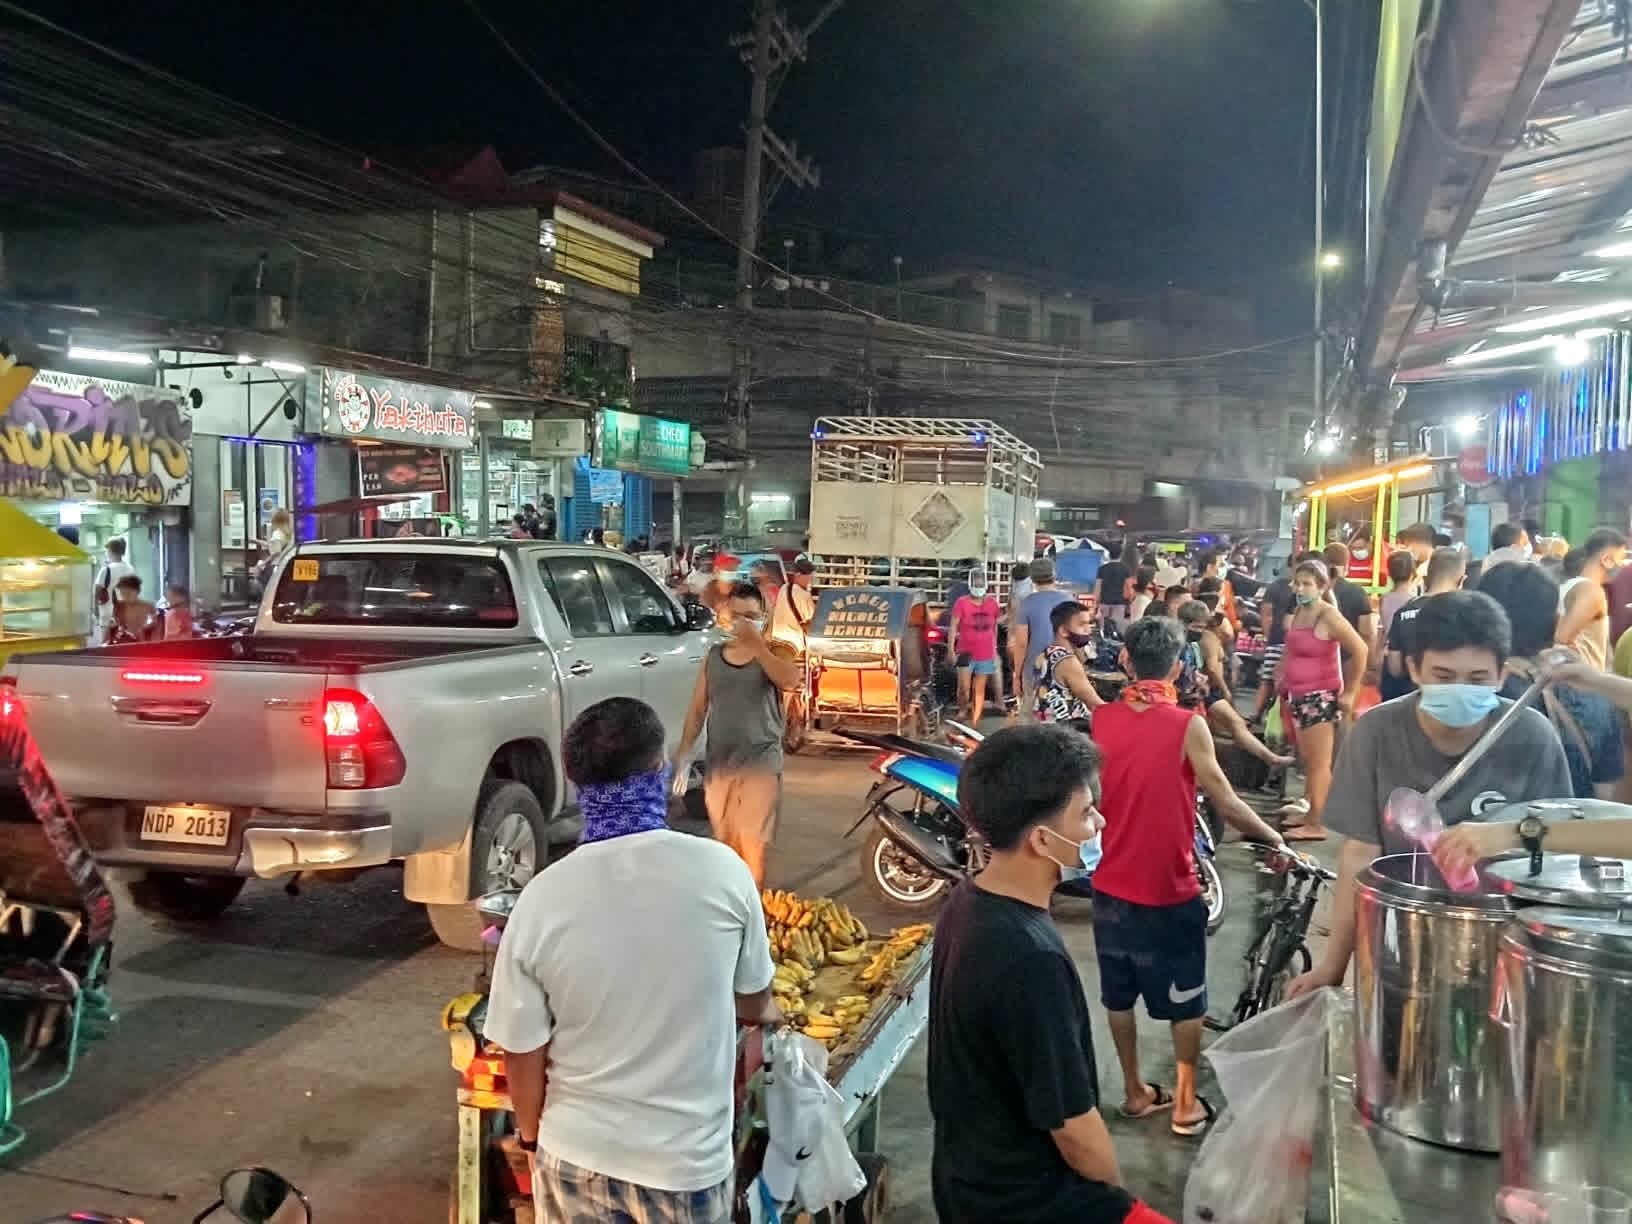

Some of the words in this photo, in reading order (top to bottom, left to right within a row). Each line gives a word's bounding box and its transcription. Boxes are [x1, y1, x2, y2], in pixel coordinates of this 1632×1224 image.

[370, 388, 467, 436] Yakibuta
[143, 812, 175, 834] NDP
[184, 816, 227, 837] 2013
